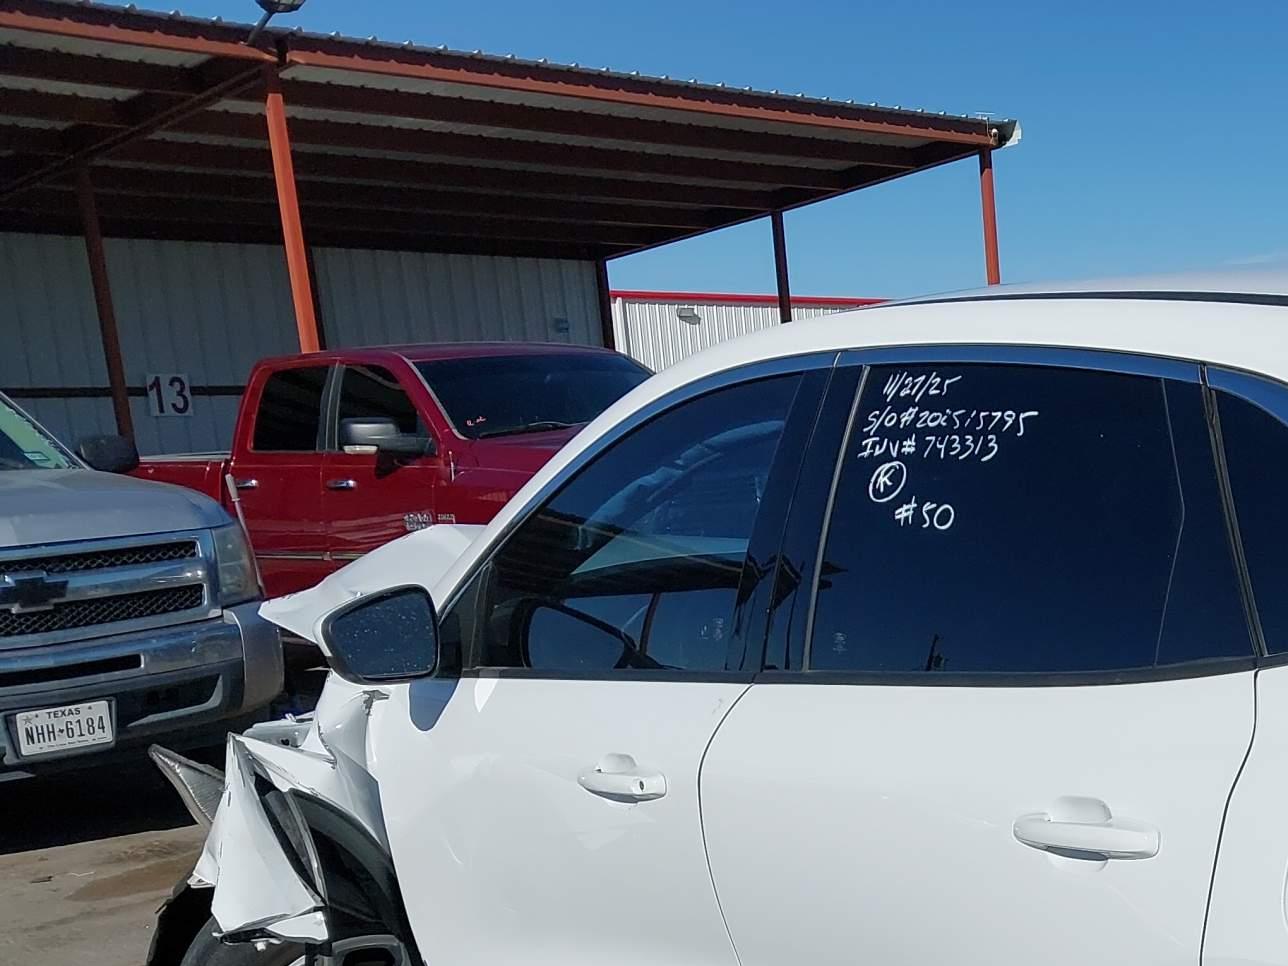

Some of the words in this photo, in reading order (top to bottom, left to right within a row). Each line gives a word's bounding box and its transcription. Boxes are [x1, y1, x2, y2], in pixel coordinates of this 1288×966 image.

[148, 375, 190, 415] 13
[883, 371, 962, 402] 11/27/25
[923, 434, 999, 462] 743313
[894, 496, 955, 530] #50
[46, 707, 81, 720] TEXAS
